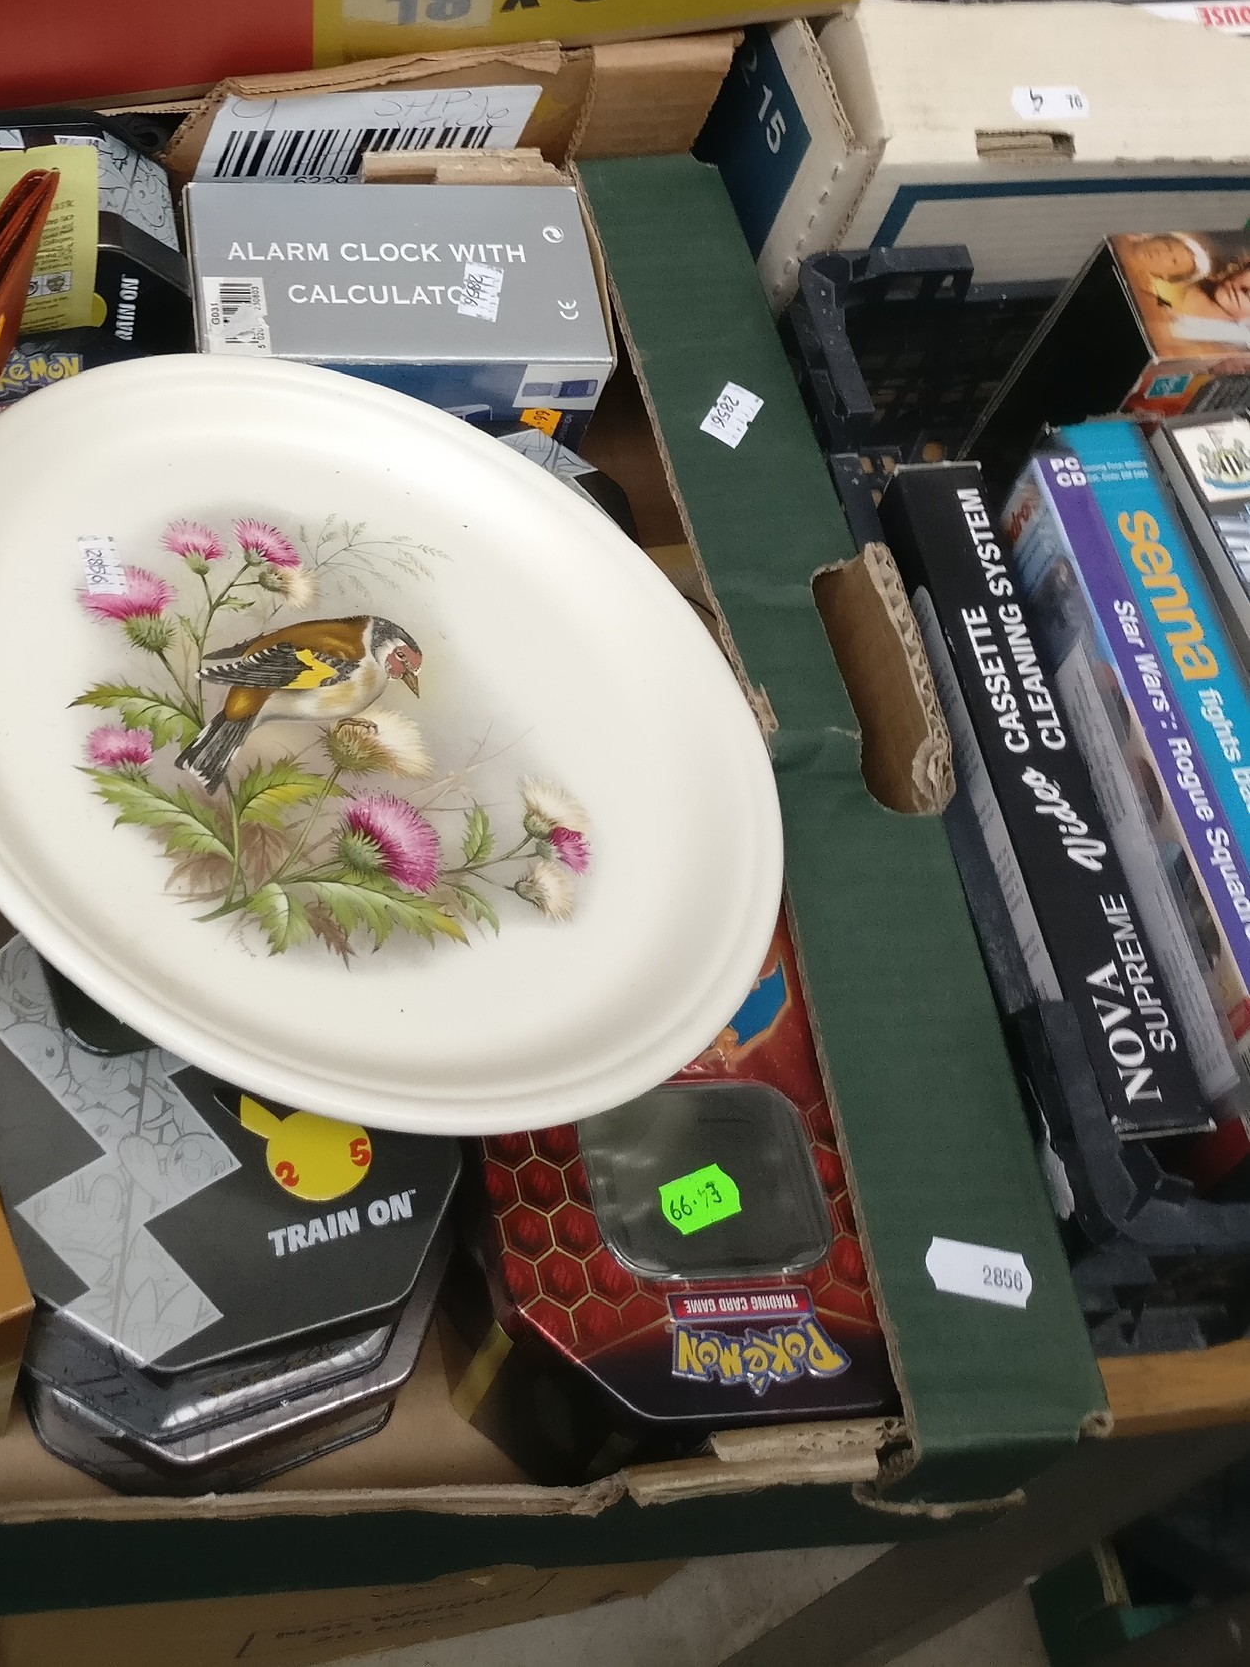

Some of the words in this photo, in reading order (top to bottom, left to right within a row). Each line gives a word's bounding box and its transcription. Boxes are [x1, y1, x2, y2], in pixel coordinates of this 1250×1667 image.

[756, 83, 787, 154] 15
[227, 242, 329, 262] ALARM
[340, 243, 441, 262] CLOCK
[450, 244, 526, 263] WITH
[288, 284, 463, 306] CALCULATO
[467, 272, 489, 308] 2856
[211, 302, 220, 326] G031
[712, 391, 741, 430] 2856
[1050, 457, 1082, 472] PC
[1057, 471, 1086, 487] CD
[957, 488, 1013, 597] SYSTEM
[82, 546, 104, 586] 2856
[1117, 510, 1219, 681] senna
[1198, 688, 1243, 762] fights
[962, 605, 1030, 754] CASSETTE
[998, 604, 1067, 751] CLEANING
[1113, 600, 1146, 648] Star
[1167, 736, 1215, 821] Rogue
[1099, 894, 1177, 1052] SUPREME
[1086, 960, 1162, 1105] NOVA
[349, 1138, 371, 1167] 5
[275, 1161, 299, 1187] 2
[268, 1207, 360, 1256] TRAIN
[368, 1191, 413, 1226] ON
[982, 1263, 1025, 1293] 2856
[684, 1299, 716, 1314] GAME
[718, 1297, 748, 1312] CARD
[751, 1294, 798, 1310] TRADING
